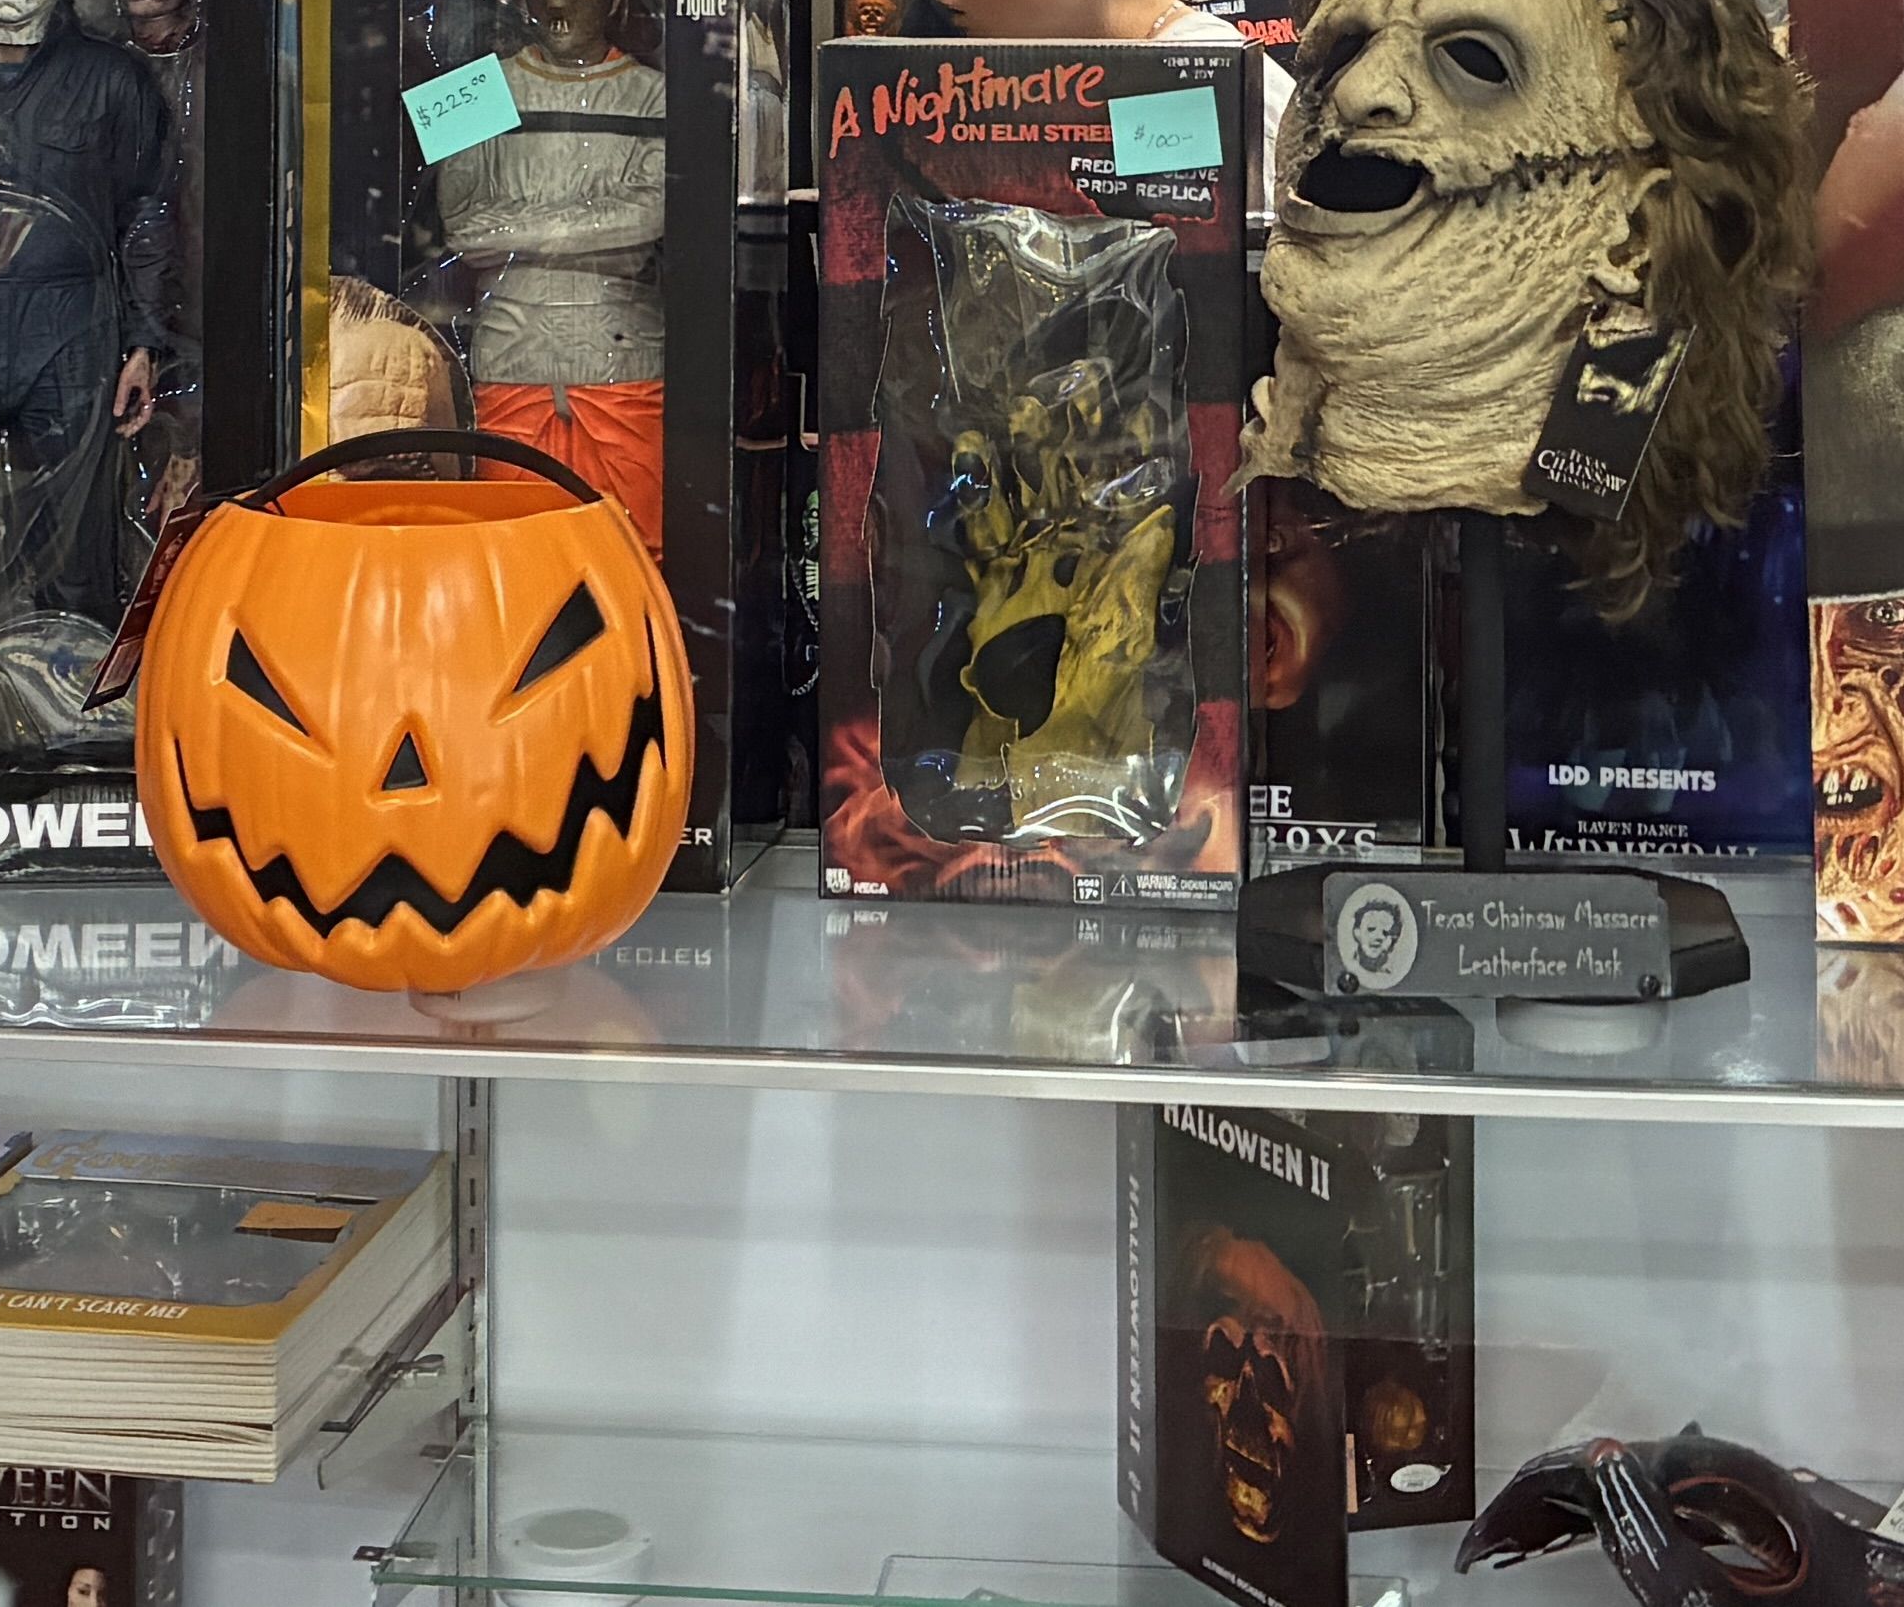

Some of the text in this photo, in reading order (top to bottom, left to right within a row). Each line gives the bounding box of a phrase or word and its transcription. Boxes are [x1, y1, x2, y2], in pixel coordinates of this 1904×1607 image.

[829, 56, 1110, 159] A Nightmare
[951, 123, 1113, 144] ON ELM STREE
[1076, 178, 1211, 201] PROP REPLICA
[1548, 763, 1717, 793] LDD PRESENTS
[1637, 820, 1688, 838] DANCE
[1422, 899, 1661, 932] Texas Chainsaw Massacre
[1458, 945, 1624, 978] Leatherface Mask
[1163, 1104, 1330, 1201] HALLOWEEN II
[6, 1294, 70, 1314] CAN'T
[72, 1298, 141, 1318] SCARE
[143, 1303, 189, 1319] ME!
